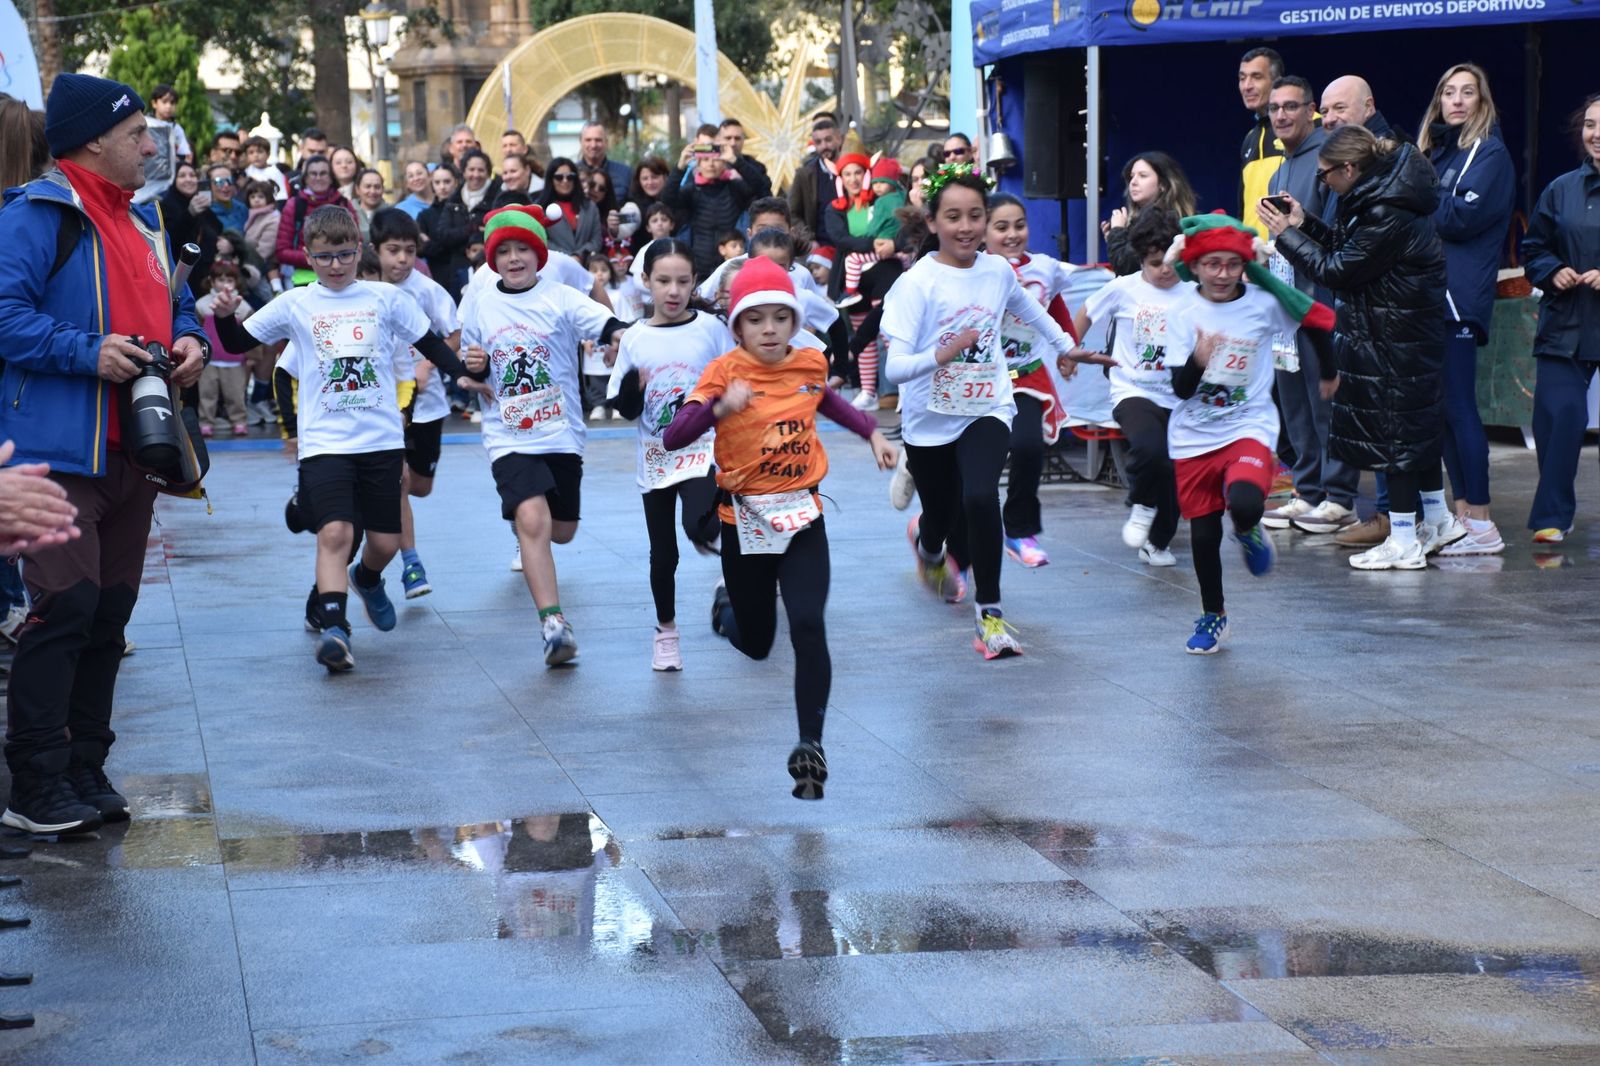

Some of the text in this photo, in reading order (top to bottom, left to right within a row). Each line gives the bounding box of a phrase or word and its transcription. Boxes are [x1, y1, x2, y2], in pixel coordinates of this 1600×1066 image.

[1279, 0, 1545, 24] GESTIÓN DE EVENTOS DEPORTIVOS
[352, 326, 364, 341] 6
[1225, 353, 1249, 371] 26
[963, 381, 995, 399] 372
[532, 402, 562, 423] 454
[775, 419, 806, 436] TRI
[674, 453, 706, 470] 278
[770, 510, 811, 533] 615
